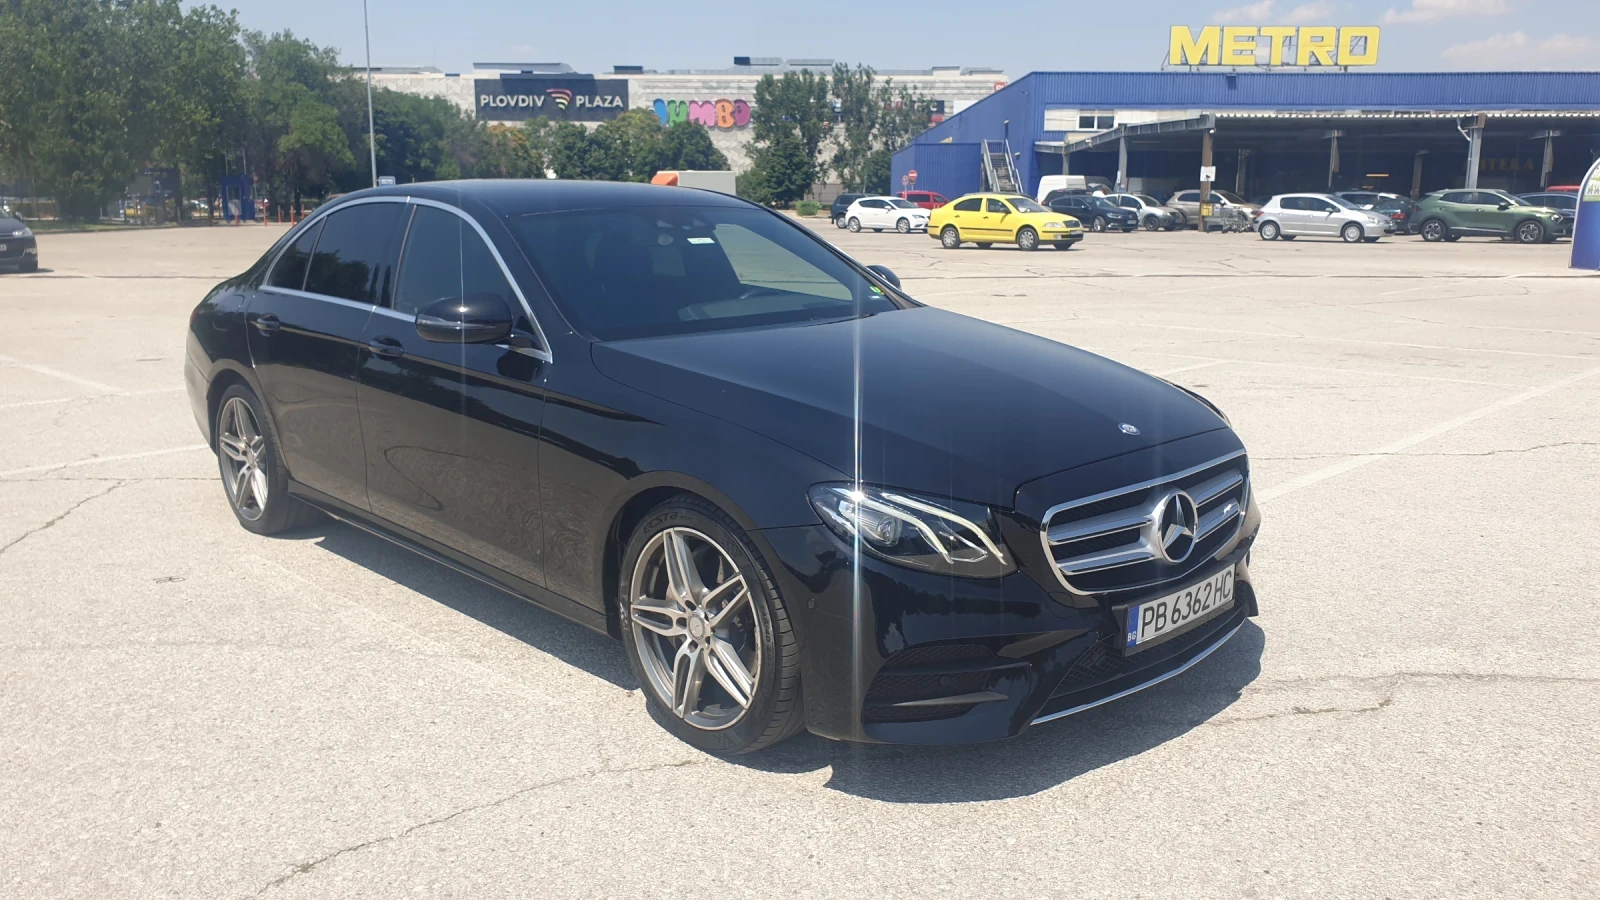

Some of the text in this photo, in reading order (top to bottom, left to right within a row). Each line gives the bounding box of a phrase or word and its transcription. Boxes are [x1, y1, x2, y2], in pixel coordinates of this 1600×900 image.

[1169, 25, 1381, 66] METRO
[480, 94, 624, 108] PLOVDIV PLAZA
[650, 98, 751, 129] JUMBO
[1140, 570, 1232, 638] PB 6362 HC
[1127, 631, 1137, 642] BG
